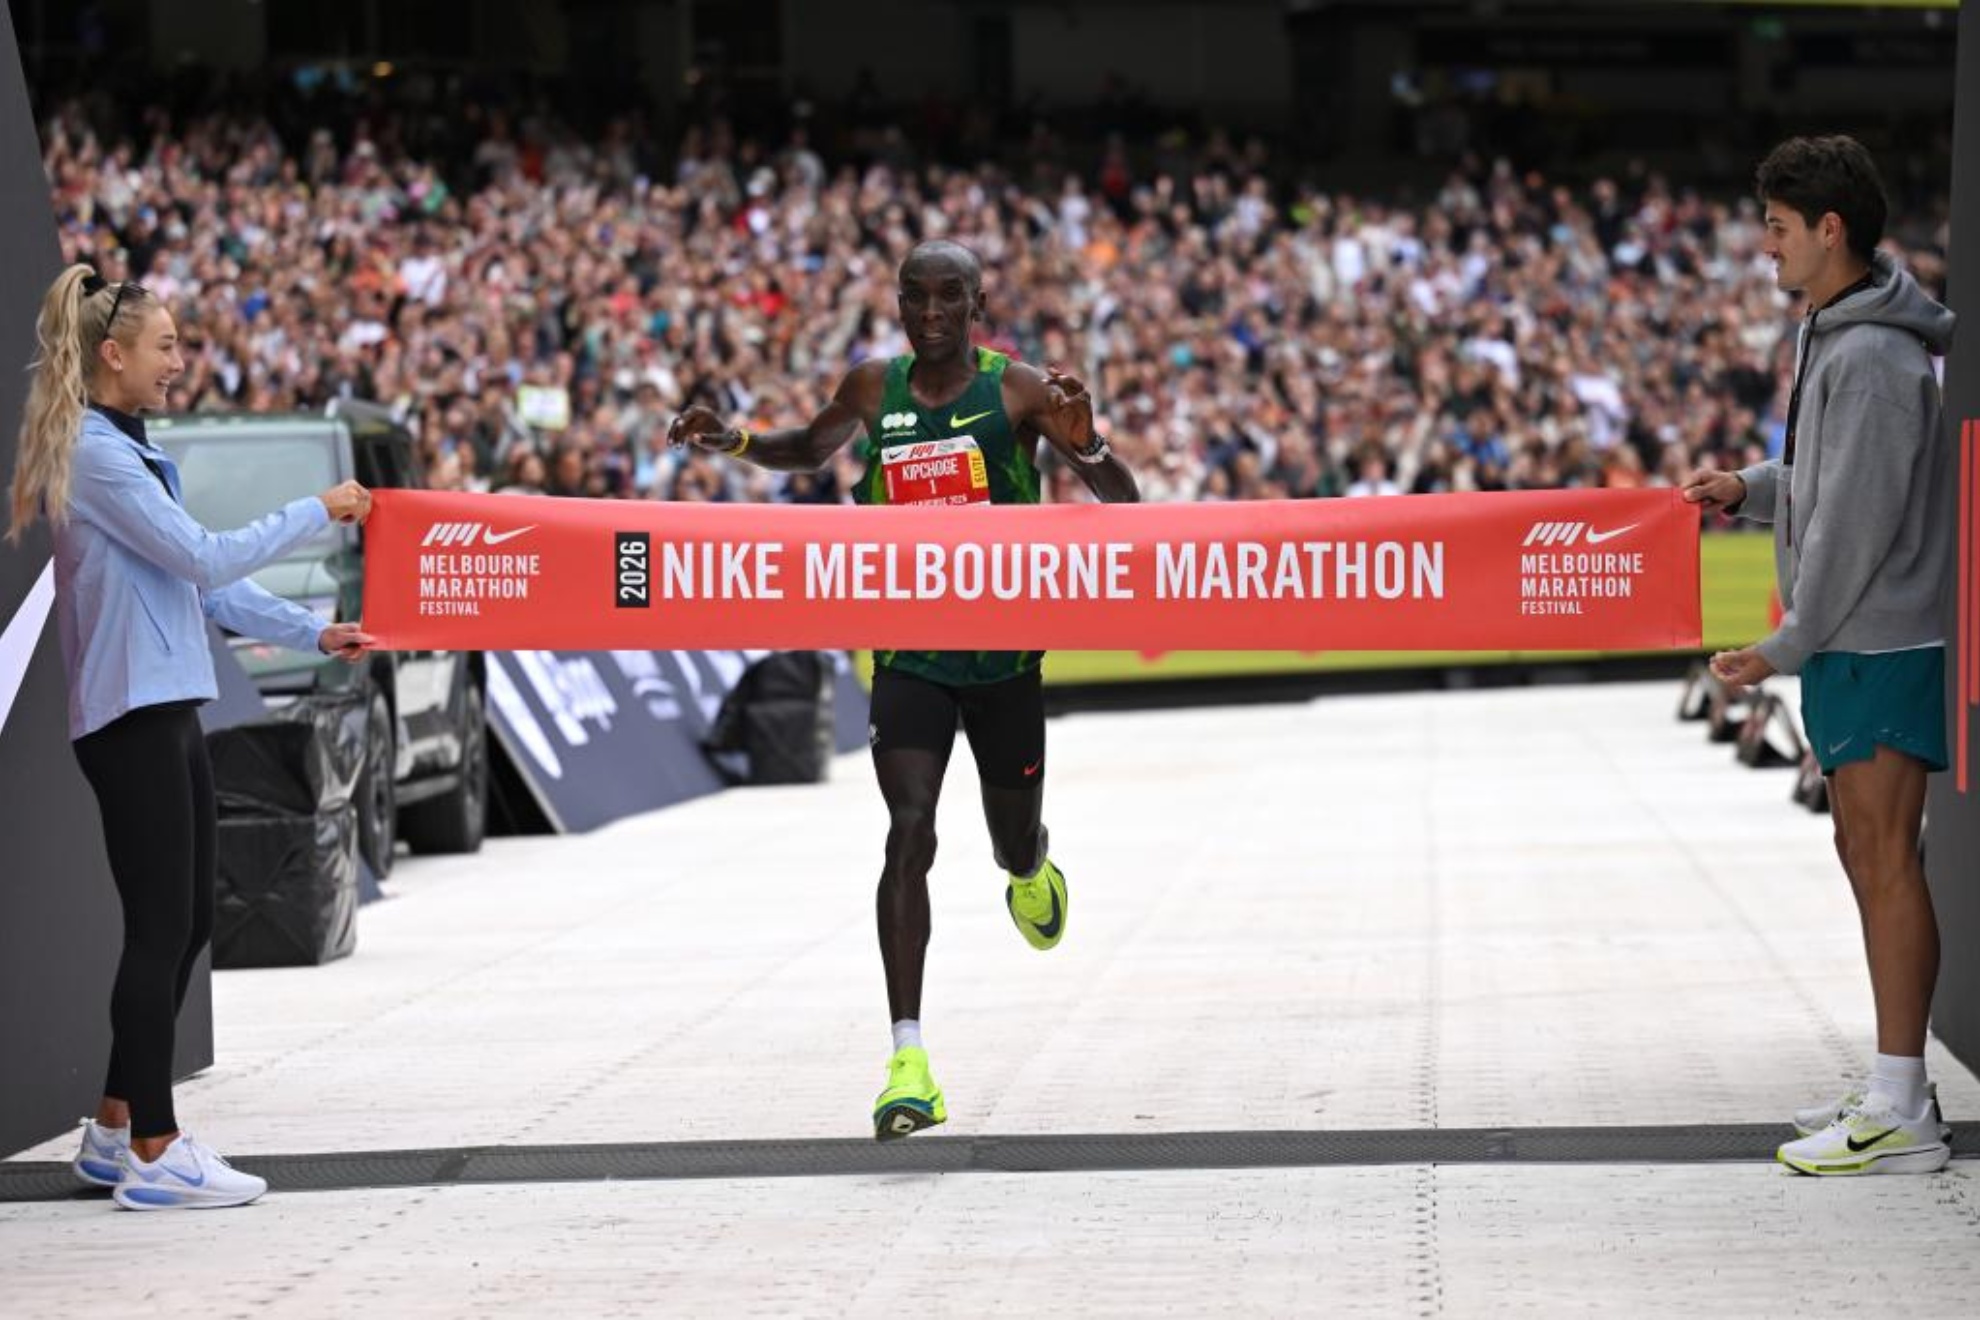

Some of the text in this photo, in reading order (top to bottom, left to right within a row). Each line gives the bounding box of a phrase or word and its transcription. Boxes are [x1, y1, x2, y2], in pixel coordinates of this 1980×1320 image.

[903, 458, 959, 480] KIPCHOGE
[930, 479, 937, 495] 1
[420, 555, 540, 575] MELBOURNE
[619, 541, 647, 600] 2026
[663, 541, 1444, 600] NIKE MELBOURNE MARATHON
[1521, 553, 1643, 574] MELBOURNE
[420, 577, 527, 598] MARATHON
[1521, 577, 1631, 597] MARATHON
[420, 601, 480, 615] FESTIVAL
[1521, 601, 1583, 614] FESTIVAL
